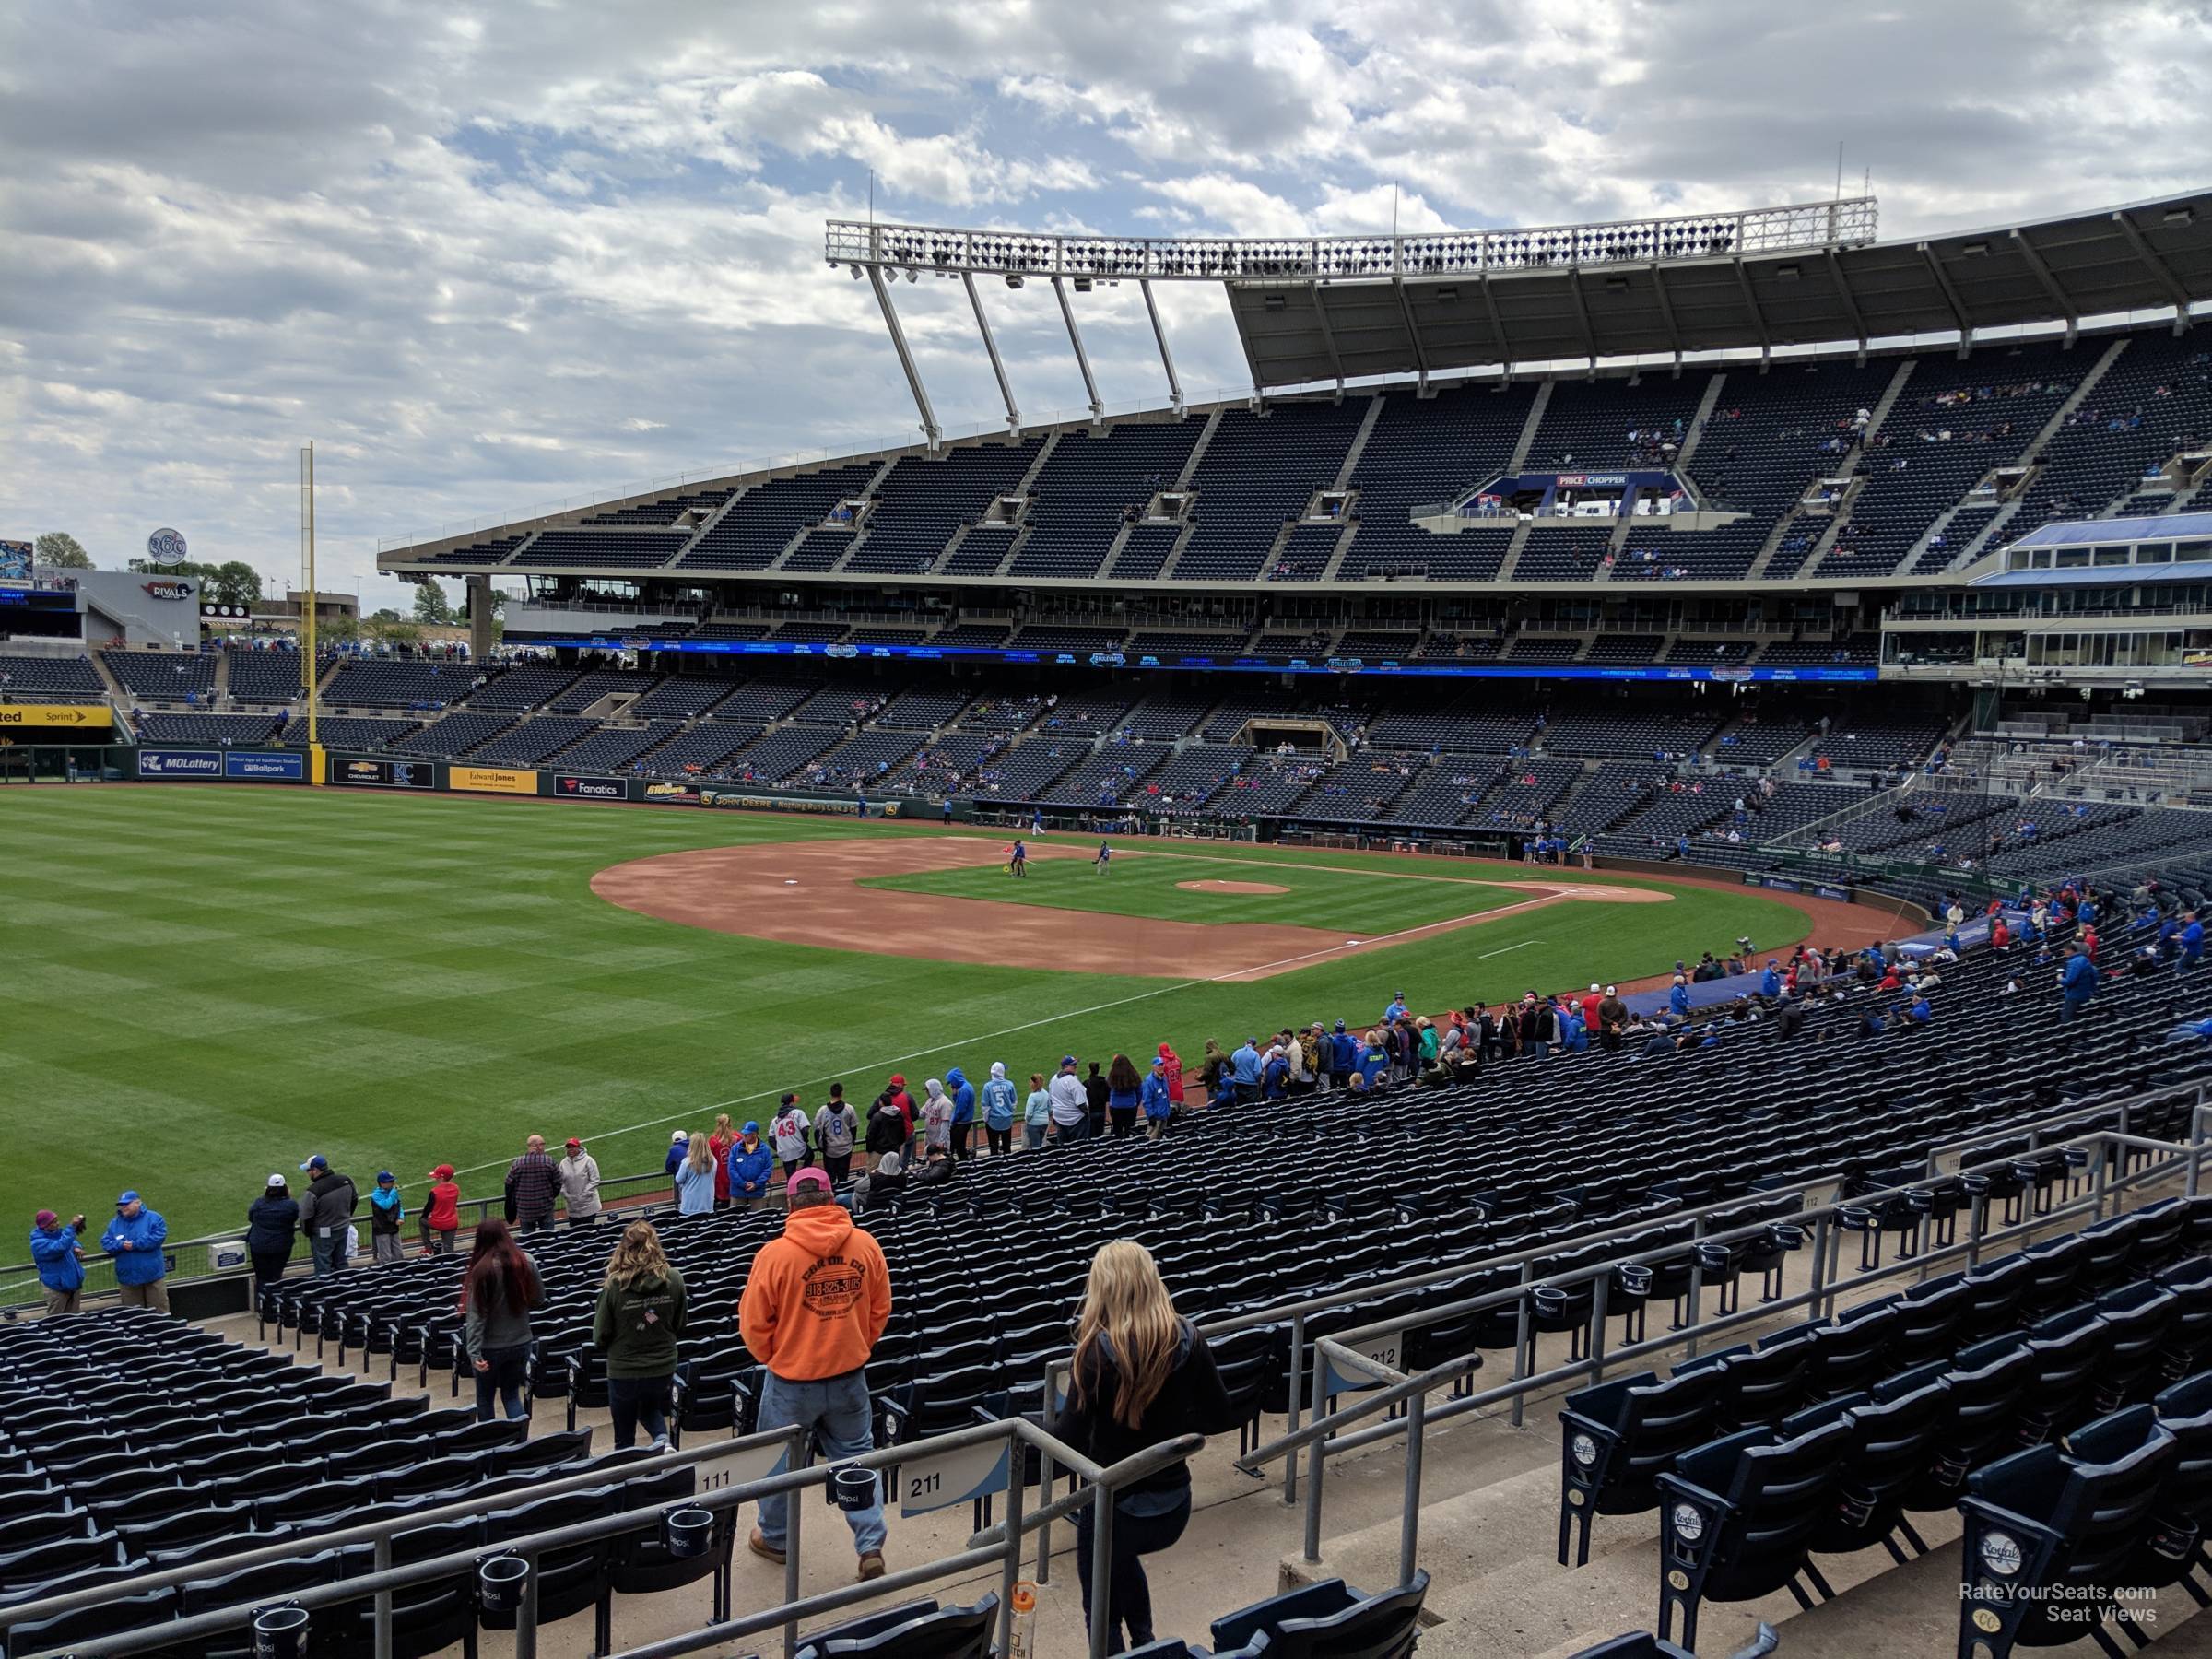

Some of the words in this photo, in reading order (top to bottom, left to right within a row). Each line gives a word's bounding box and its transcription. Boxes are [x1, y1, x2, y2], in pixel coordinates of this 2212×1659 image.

[1559, 477, 1583, 485] PRICE
[1587, 476, 1626, 484] CHOPPER
[150, 534, 186, 557] 360
[154, 587, 188, 597] RIVALS
[46, 712, 73, 722] Sprint
[166, 758, 219, 770] MOLottery
[253, 764, 285, 772] Ballpark
[469, 771, 494, 782] Edward
[494, 773, 516, 782] Jones
[579, 782, 617, 795] Fanatics
[716, 796, 739, 806] JOHN
[742, 797, 772, 808] DEERE
[1369, 1053, 1384, 1062] STAFF
[995, 1093, 1005, 1106] 5
[832, 1119, 842, 1135] 8
[929, 1117, 939, 1125] 27
[778, 1120, 796, 1137] 43
[1806, 1197, 1818, 1207] 112
[806, 1278, 861, 1296] 918-825-3105
[1539, 1304, 1558, 1312] pepsi
[703, 1470, 729, 1490] 111
[911, 1472, 940, 1498] 211
